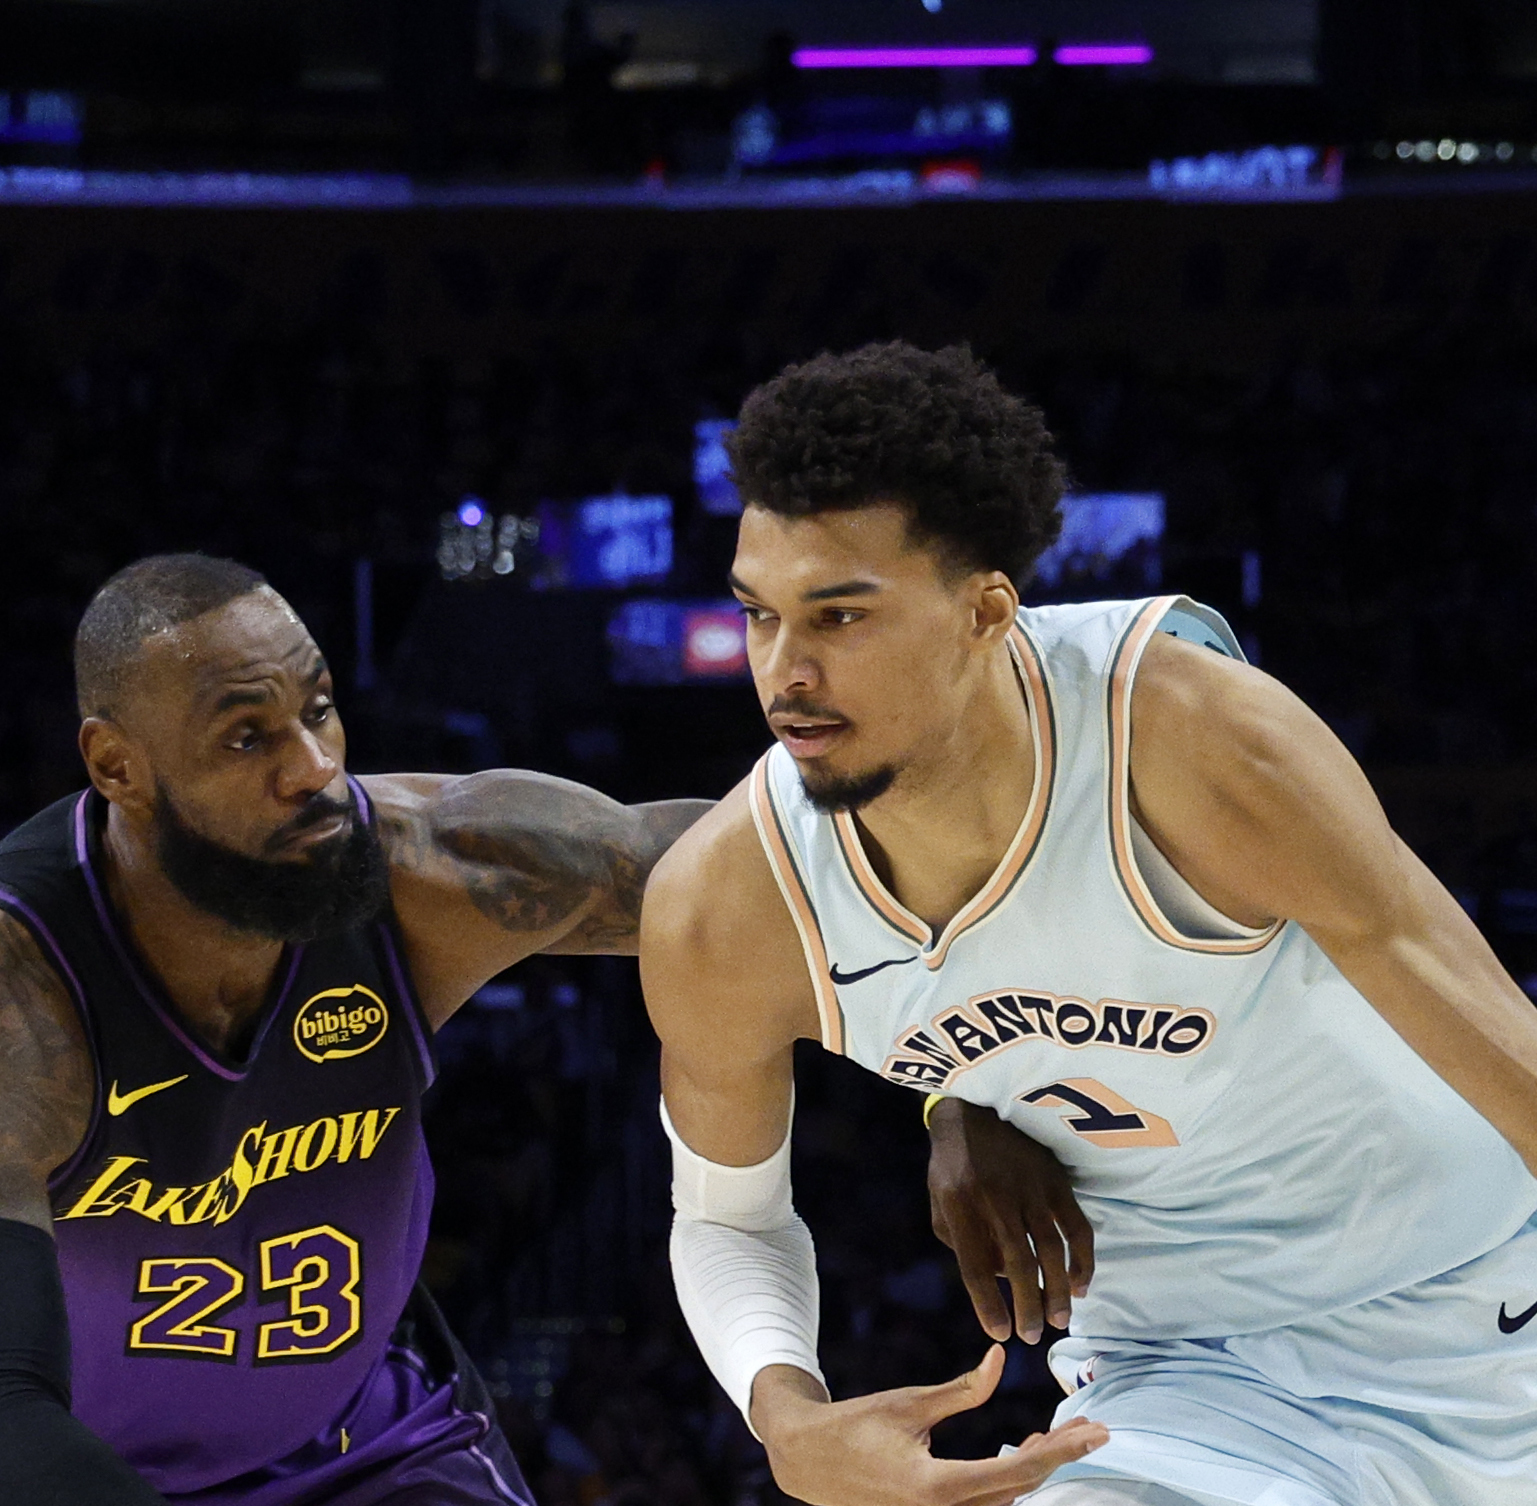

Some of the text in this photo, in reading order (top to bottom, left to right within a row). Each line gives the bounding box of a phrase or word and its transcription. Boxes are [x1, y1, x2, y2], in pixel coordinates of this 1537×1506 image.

[301, 1005, 381, 1039] bibigo
[316, 1030, 351, 1046] 비비고
[934, 990, 1212, 1066] ANTONIO
[1014, 1079, 1166, 1142] 1
[129, 1225, 361, 1360] 23
